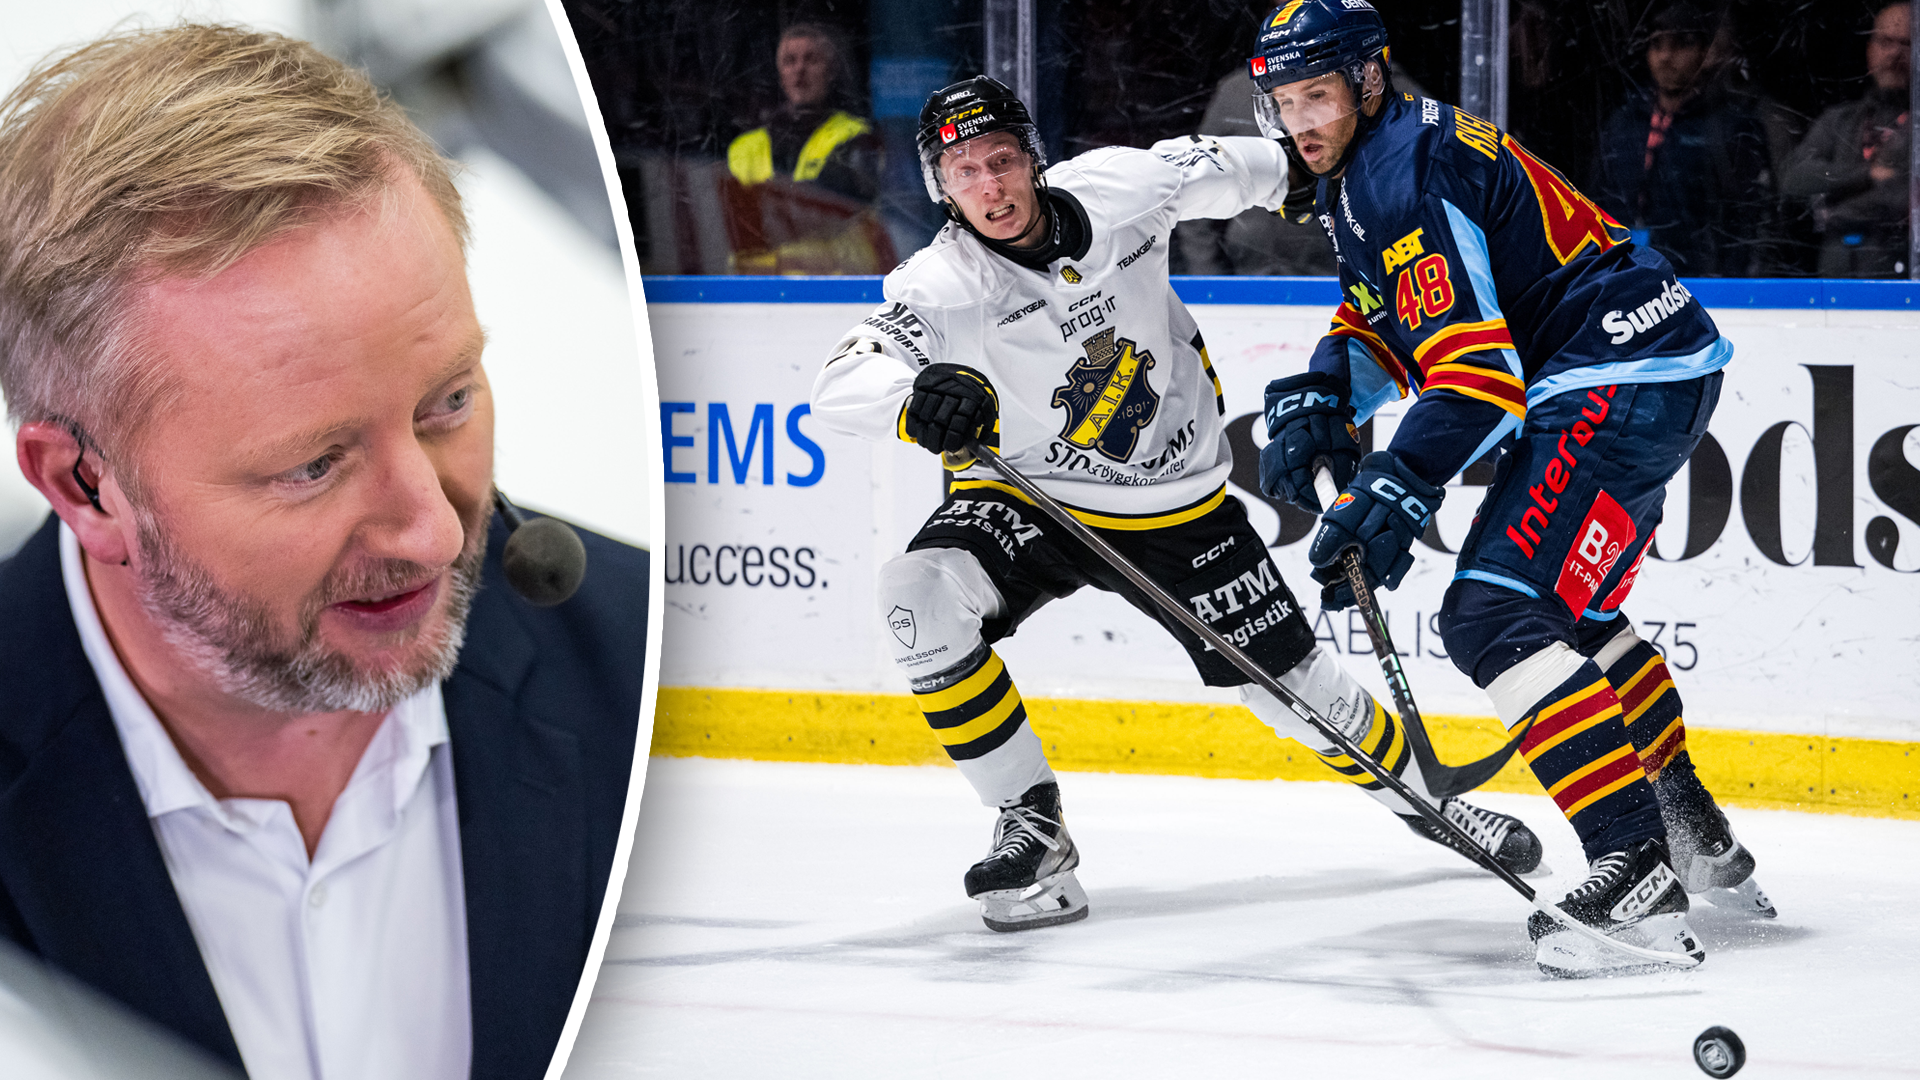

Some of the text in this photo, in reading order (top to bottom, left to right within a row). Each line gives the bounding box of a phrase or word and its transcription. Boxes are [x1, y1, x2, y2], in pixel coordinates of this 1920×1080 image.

[1267, 51, 1301, 65] SVENSKA
[1268, 62, 1286, 74] SPEL
[957, 113, 996, 131] SVENSKA
[959, 126, 981, 138] SPEL
[1117, 235, 1157, 270] TEAMGEAR
[1382, 227, 1424, 276] ABT
[1068, 290, 1102, 312] CCM
[1396, 253, 1455, 331] 48
[997, 299, 1048, 328] HOCKEYGEAR
[861, 316, 930, 367] ANSPORTER
[940, 500, 1044, 547] ATM
[665, 544, 829, 588] uccess.
[1191, 535, 1235, 569] CCM
[1189, 558, 1280, 625] ATM
[892, 618, 911, 630] DS
[911, 676, 945, 690] CCM
[1621, 864, 1669, 914] CCM
